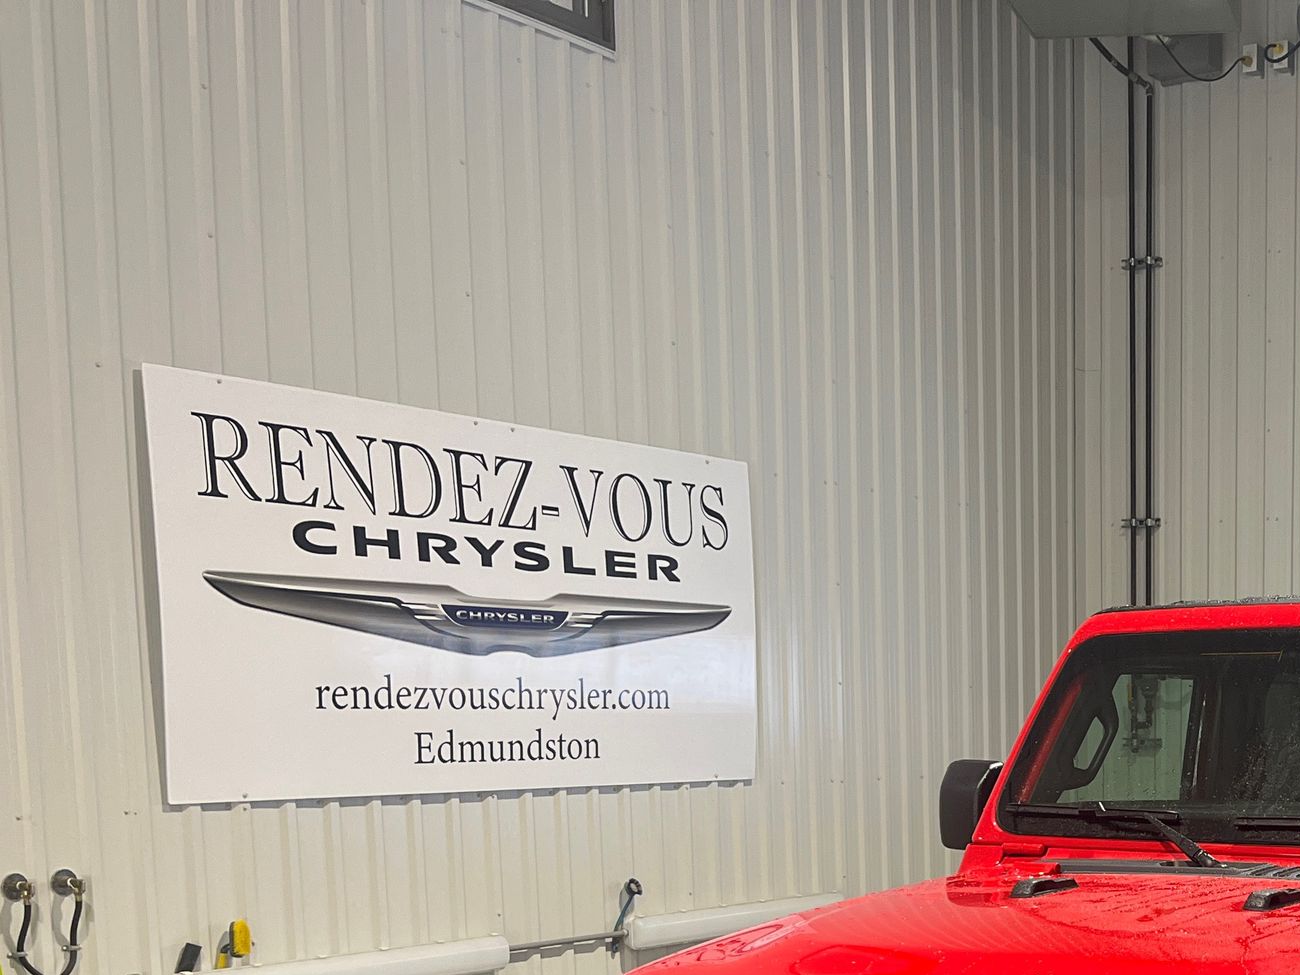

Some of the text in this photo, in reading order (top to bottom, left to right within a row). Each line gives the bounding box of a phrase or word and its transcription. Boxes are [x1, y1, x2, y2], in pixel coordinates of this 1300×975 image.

[190, 411, 730, 551] RENDEZ-VOUS
[291, 519, 682, 583] CHRYSLER
[455, 609, 555, 624] CHRYSLER
[314, 674, 671, 721] rendezvouschrysler.com
[413, 729, 602, 765] Edmundston
